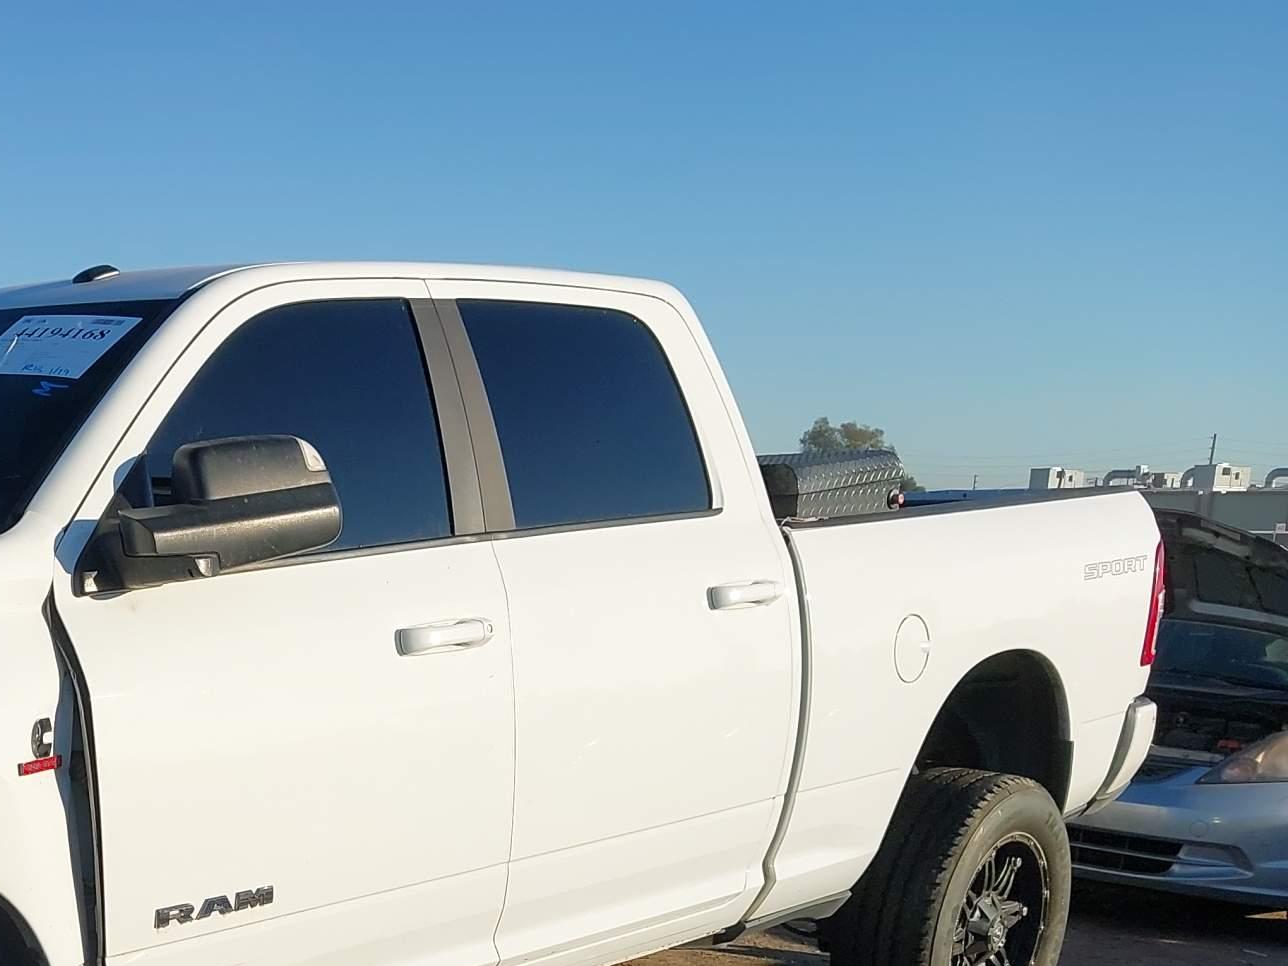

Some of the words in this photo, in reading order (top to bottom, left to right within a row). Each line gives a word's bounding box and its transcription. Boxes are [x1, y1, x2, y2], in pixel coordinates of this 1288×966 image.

[15, 327, 111, 340] 44194168
[1083, 555, 1148, 581] SPORT
[153, 885, 274, 929] RAM
